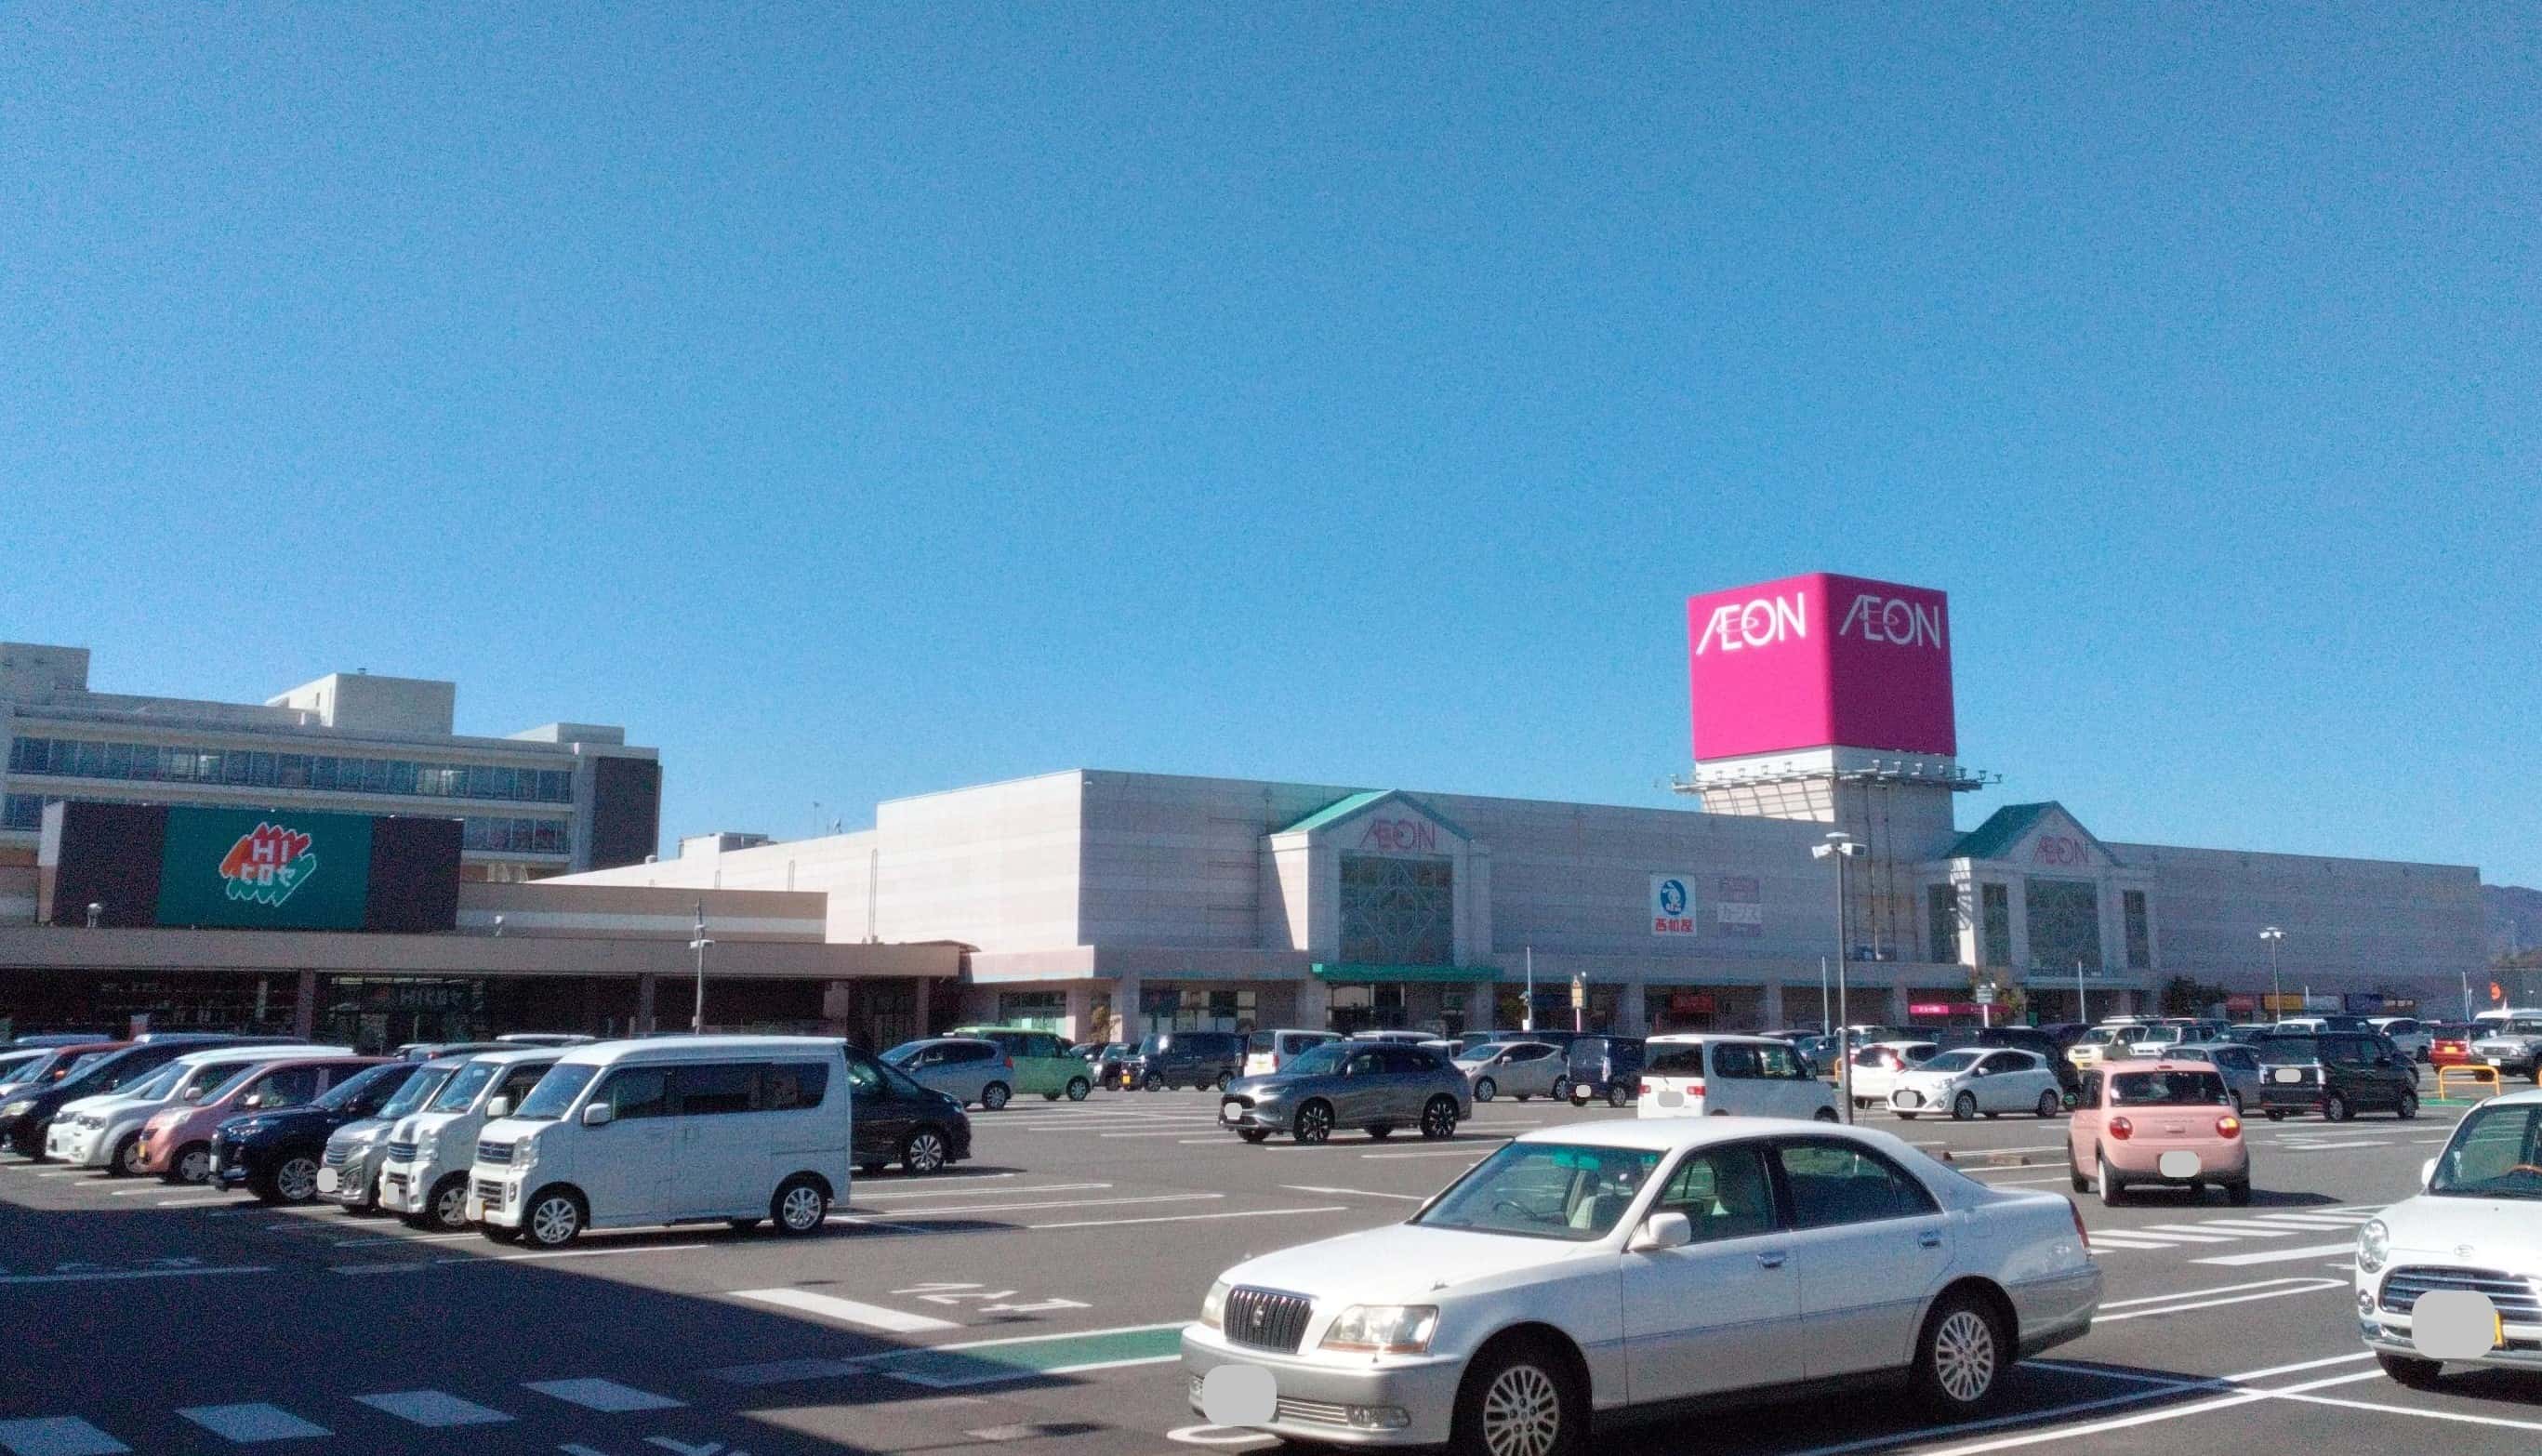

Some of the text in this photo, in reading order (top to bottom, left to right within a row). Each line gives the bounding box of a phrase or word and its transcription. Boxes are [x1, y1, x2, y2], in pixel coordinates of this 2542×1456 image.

[252, 839, 290, 863] HI
[240, 863, 297, 887] ヒロセ
